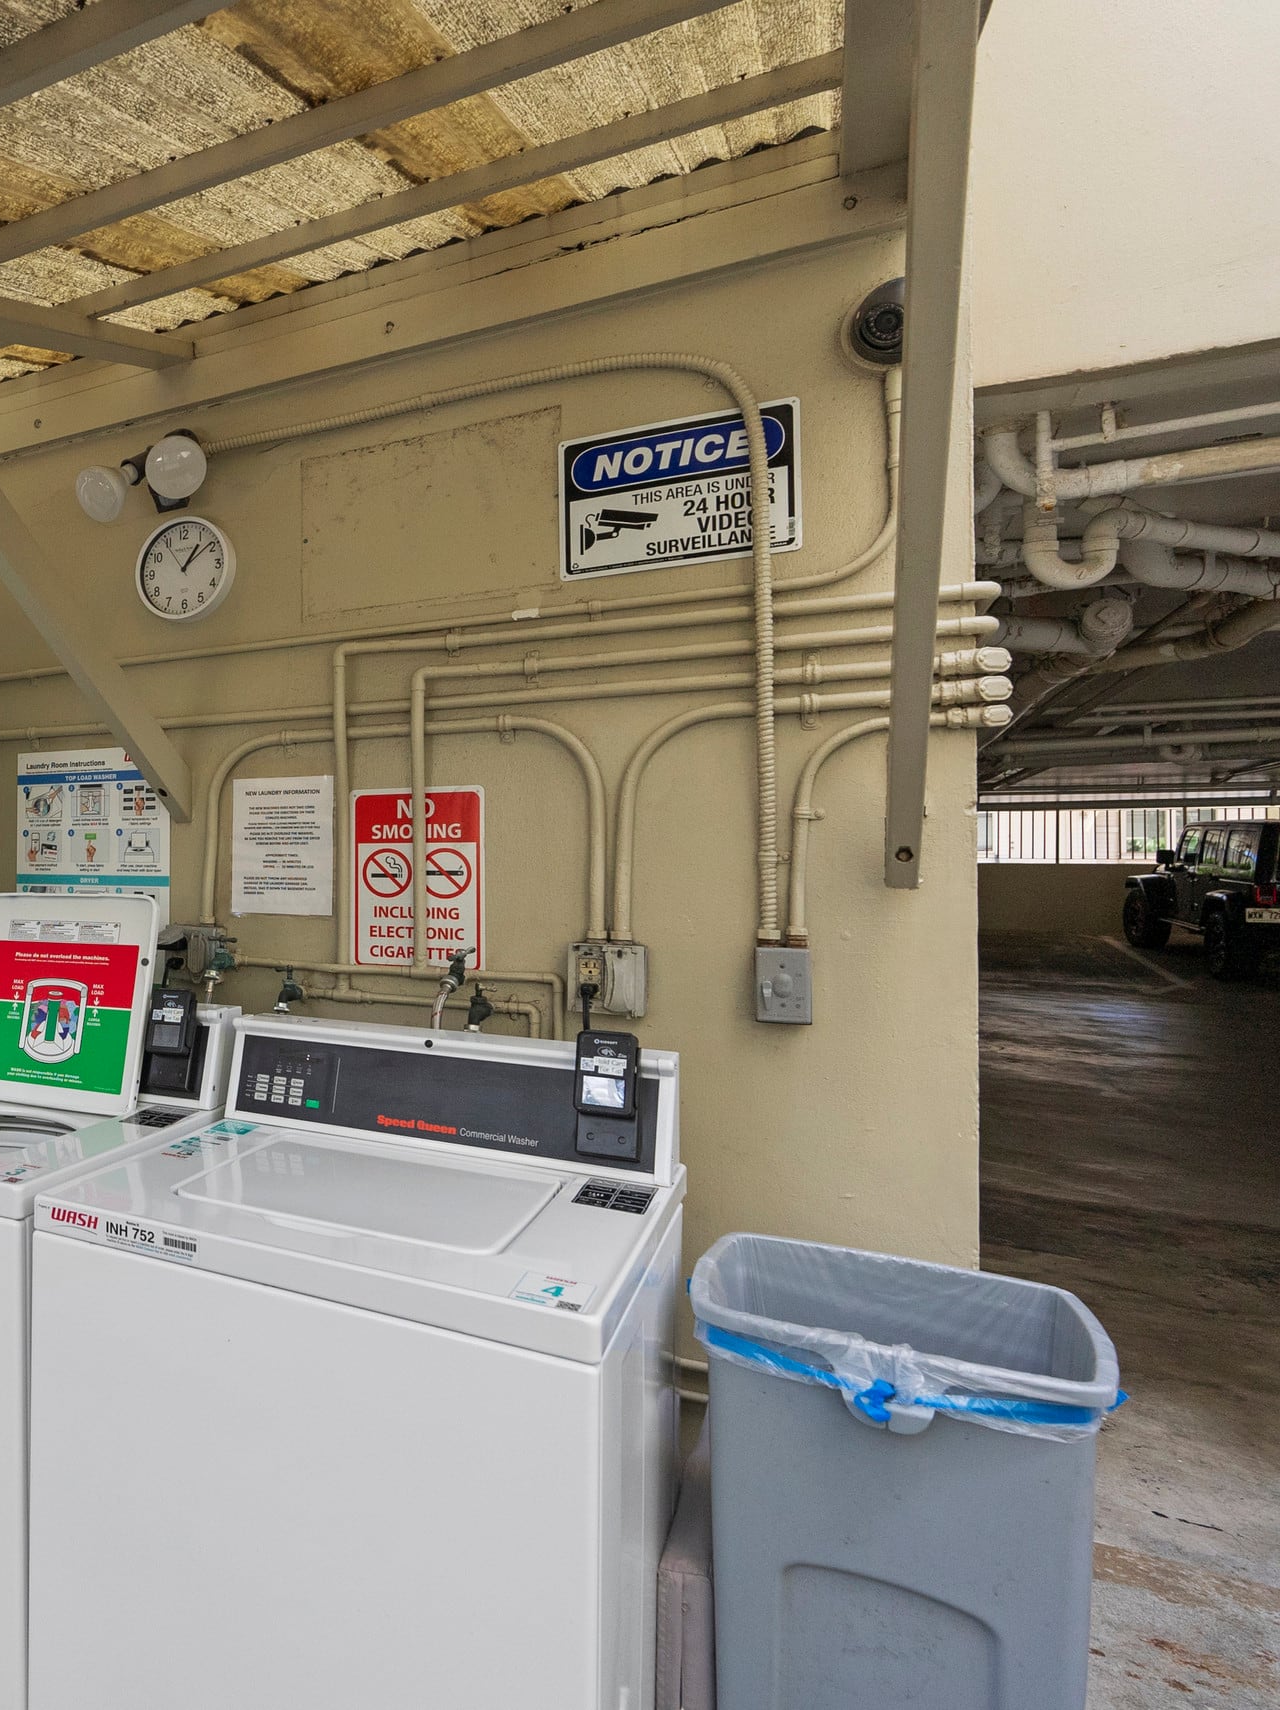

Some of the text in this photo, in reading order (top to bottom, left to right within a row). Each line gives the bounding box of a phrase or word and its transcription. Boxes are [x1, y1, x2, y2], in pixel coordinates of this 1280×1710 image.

[592, 429, 750, 482] NOTICE
[632, 472, 775, 505] THIS AREA IS UNDR
[683, 497, 708, 516] 24
[180, 529, 189, 540] 12
[646, 525, 776, 556] SURVEILLANE
[209, 542, 216, 552] 2
[154, 553, 162, 563] 10
[215, 559, 221, 569] 3
[149, 570, 155, 580] 9
[209, 577, 216, 588] 4
[154, 587, 160, 597] 8
[198, 592, 204, 603] 5
[166, 597, 172, 607] 7
[182, 599, 187, 609] 6
[26, 760, 106, 770] Laundry Room Instructions
[396, 798, 435, 819] NO
[371, 823, 462, 839] SMOING
[370, 925, 465, 941] ELECTONIC
[370, 945, 465, 960] CIGARTTE
[376, 1114, 539, 1147] Speed Queen Commercial Washer
[51, 1207, 98, 1229] WASH
[106, 1221, 128, 1237] INH
[132, 1227, 155, 1243] 752
[542, 1286, 565, 1297] 4
